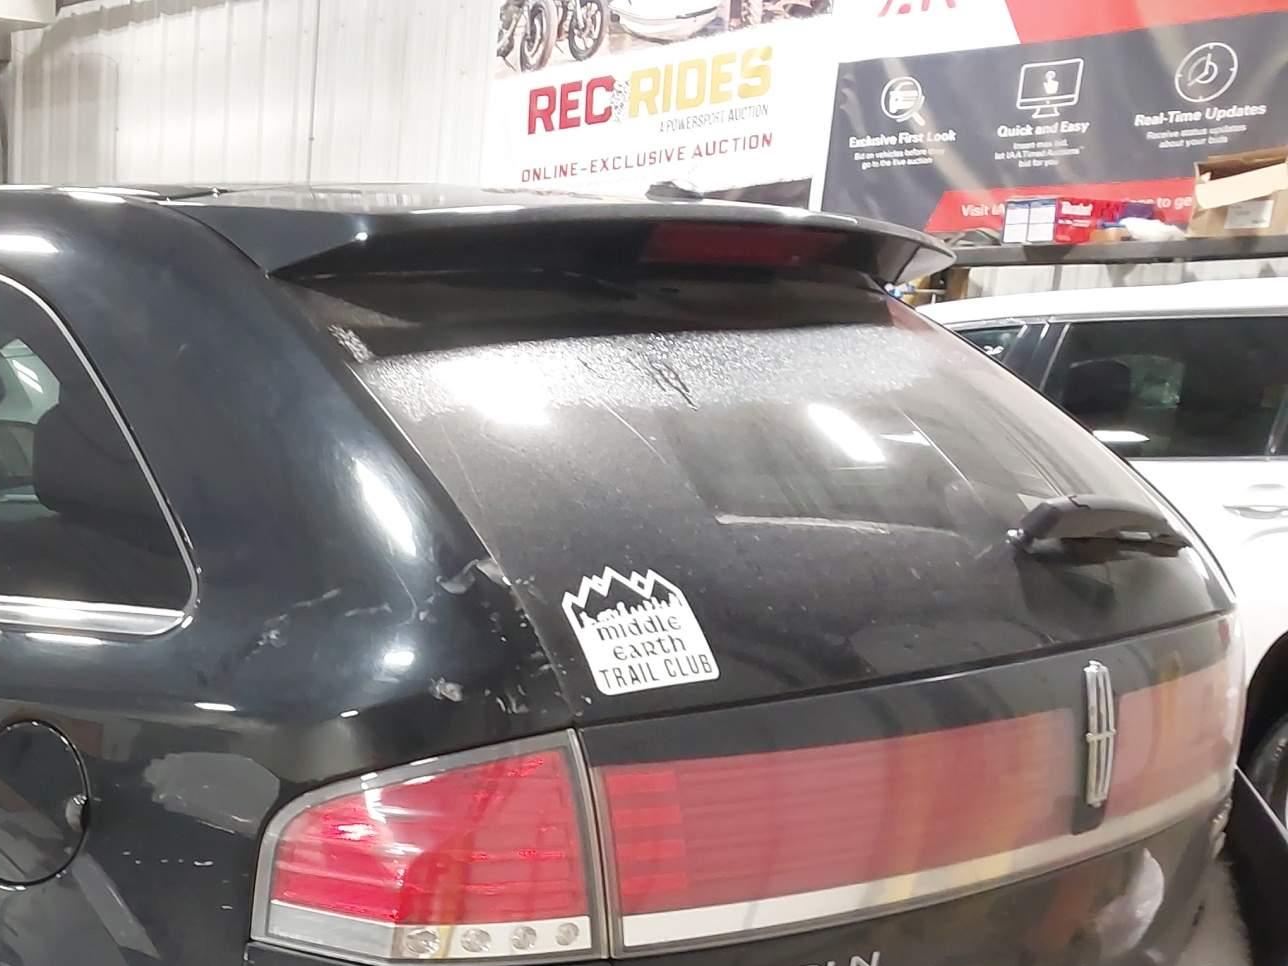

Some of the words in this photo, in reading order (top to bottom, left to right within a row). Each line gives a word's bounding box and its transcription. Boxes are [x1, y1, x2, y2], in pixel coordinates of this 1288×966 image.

[527, 75, 617, 135] REC
[628, 46, 774, 119] RIDES
[728, 104, 769, 121] AUCTION
[1134, 111, 1202, 127] Real-Time
[1205, 105, 1267, 121] Updates
[849, 134, 897, 148] Exclusive
[898, 132, 924, 144] First
[926, 129, 957, 142] Look
[997, 124, 1033, 137] Quick
[1034, 122, 1058, 135] and
[1060, 121, 1090, 133] Easy
[521, 146, 686, 183] ONLINE-EXCLUSIVE
[691, 132, 773, 160] AUCTION
[961, 203, 989, 217] Visit
[1157, 197, 1170, 208] to
[596, 614, 682, 641] middle
[599, 661, 660, 689] TRAIL
[664, 654, 713, 678] CLUB
